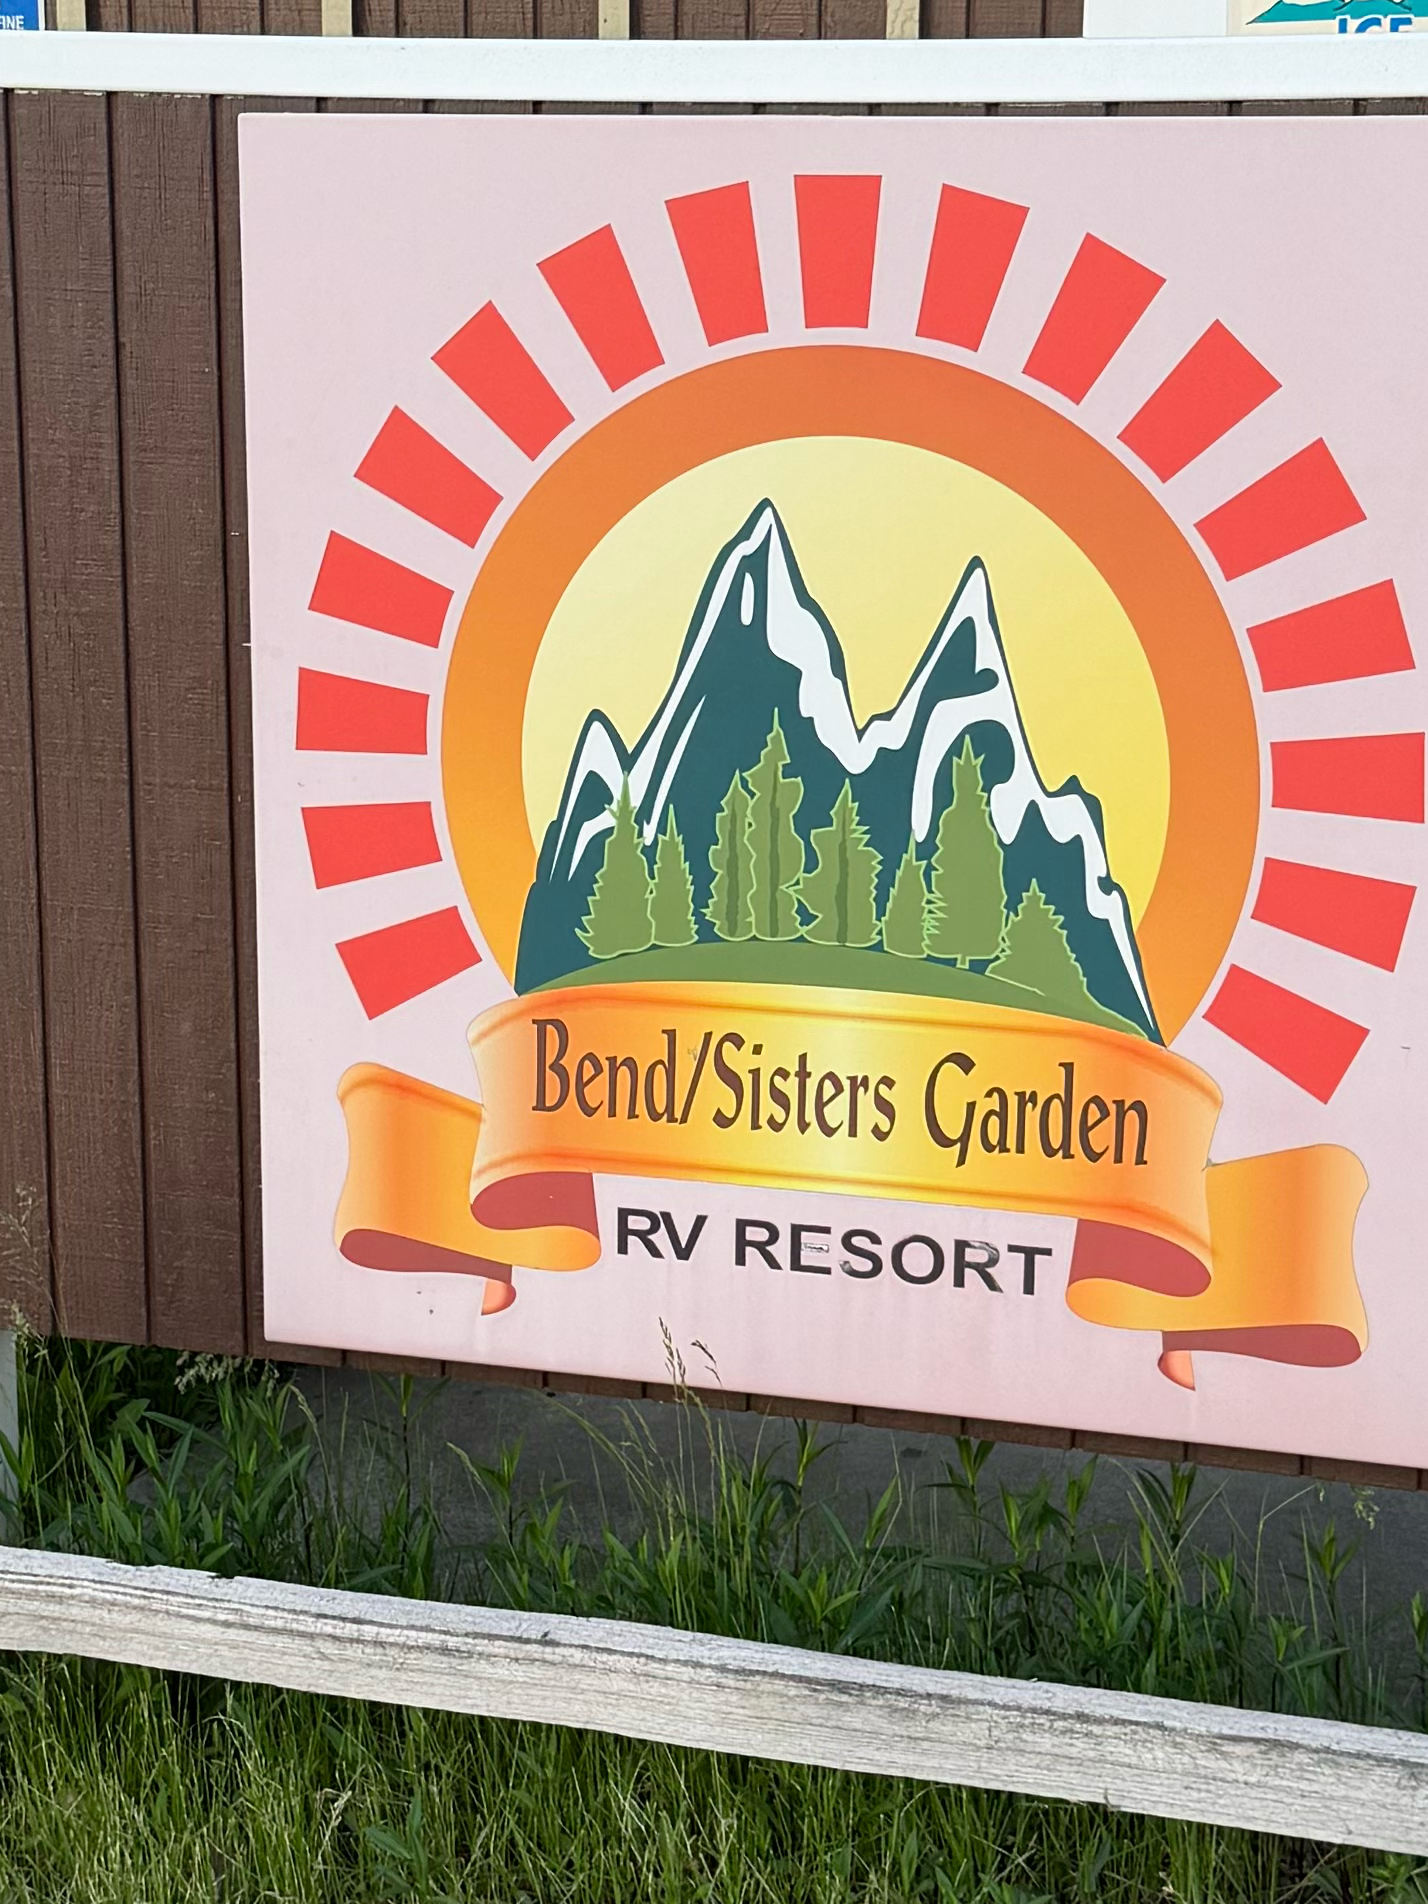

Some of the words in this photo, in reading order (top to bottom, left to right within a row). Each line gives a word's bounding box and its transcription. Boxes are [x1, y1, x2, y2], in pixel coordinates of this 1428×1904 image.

[532, 1018, 897, 1143] Bend/Sisters
[924, 1051, 1149, 1169] Garden
[616, 1207, 708, 1261] RV
[734, 1218, 1053, 1297] RESORT
